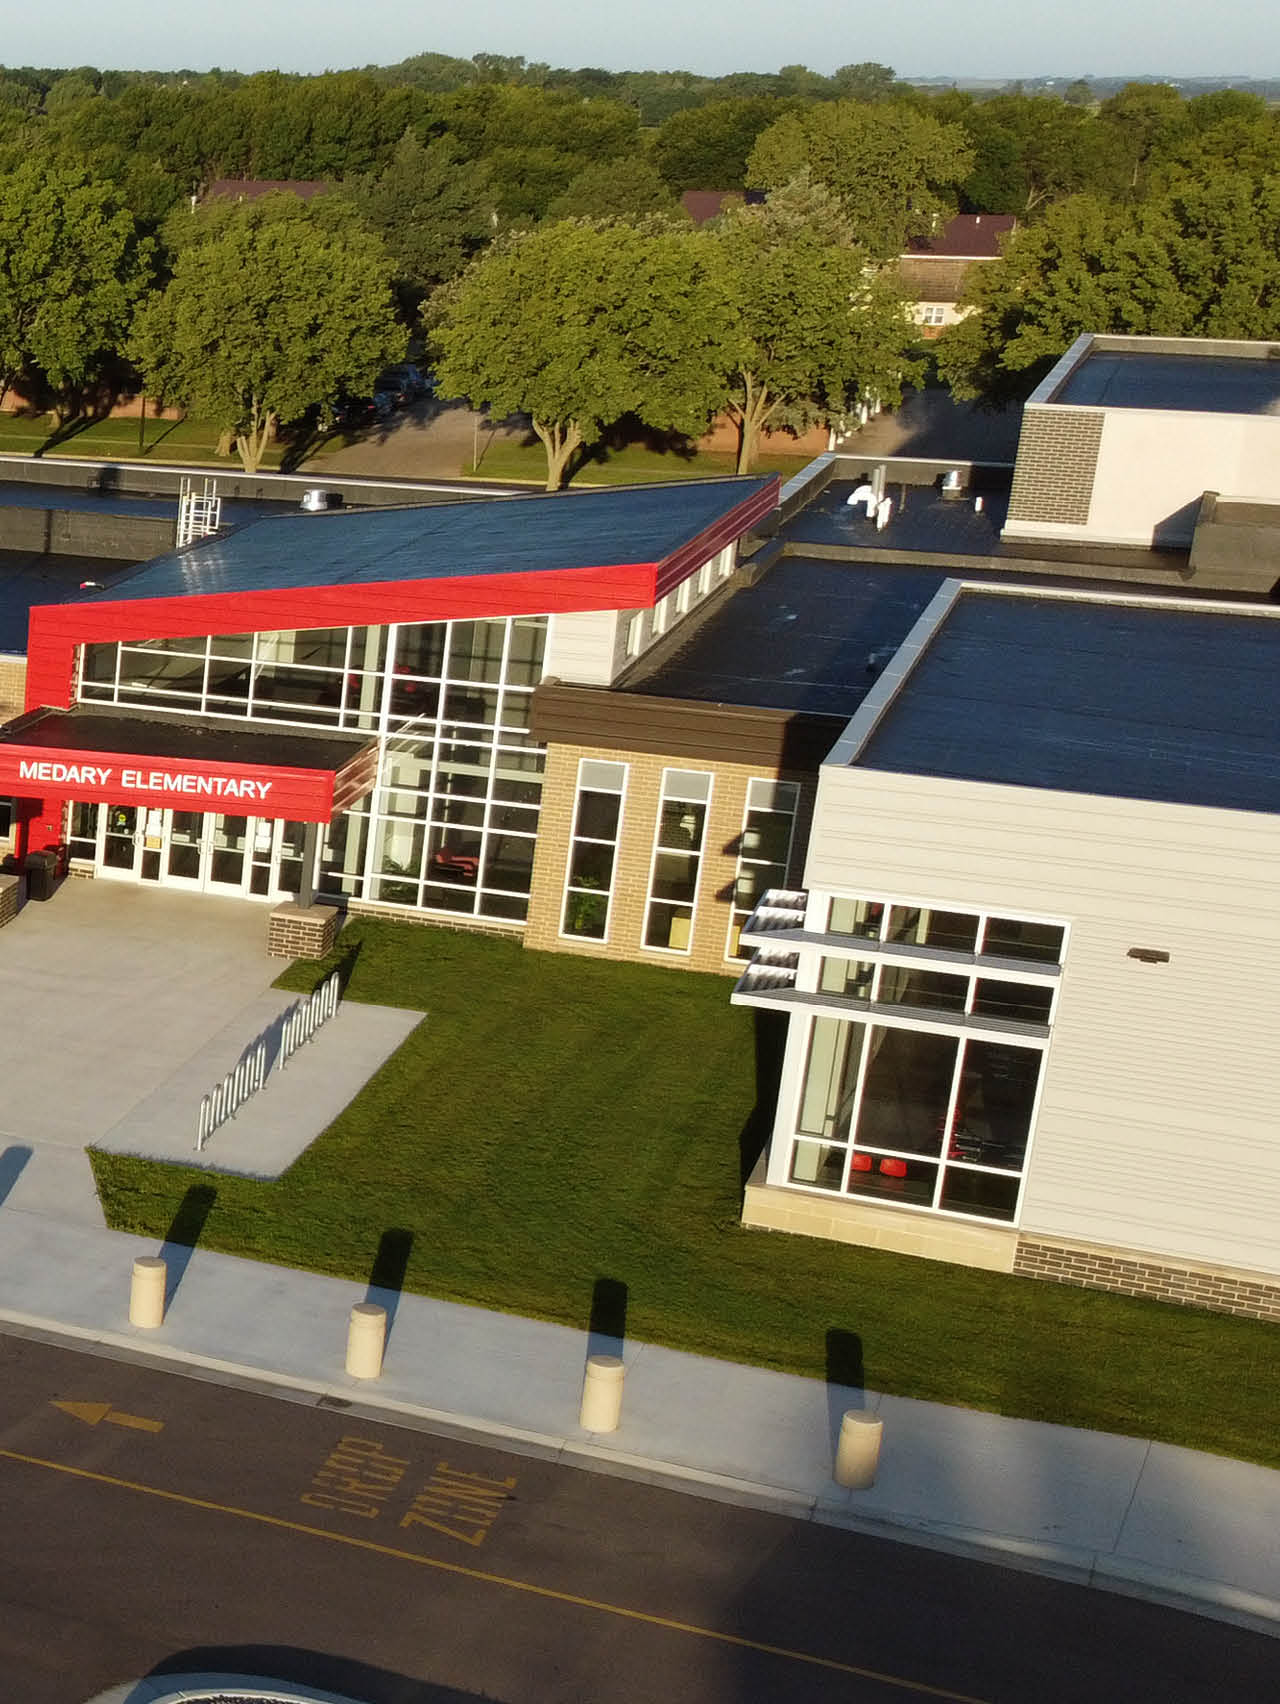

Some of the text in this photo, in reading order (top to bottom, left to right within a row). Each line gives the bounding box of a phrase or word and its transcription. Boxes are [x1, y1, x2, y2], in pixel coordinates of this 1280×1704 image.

[19, 761, 272, 799] MEDARY ELEMENTARY
[301, 1437, 410, 1518] DROP
[400, 1462, 517, 1546] ZONE
